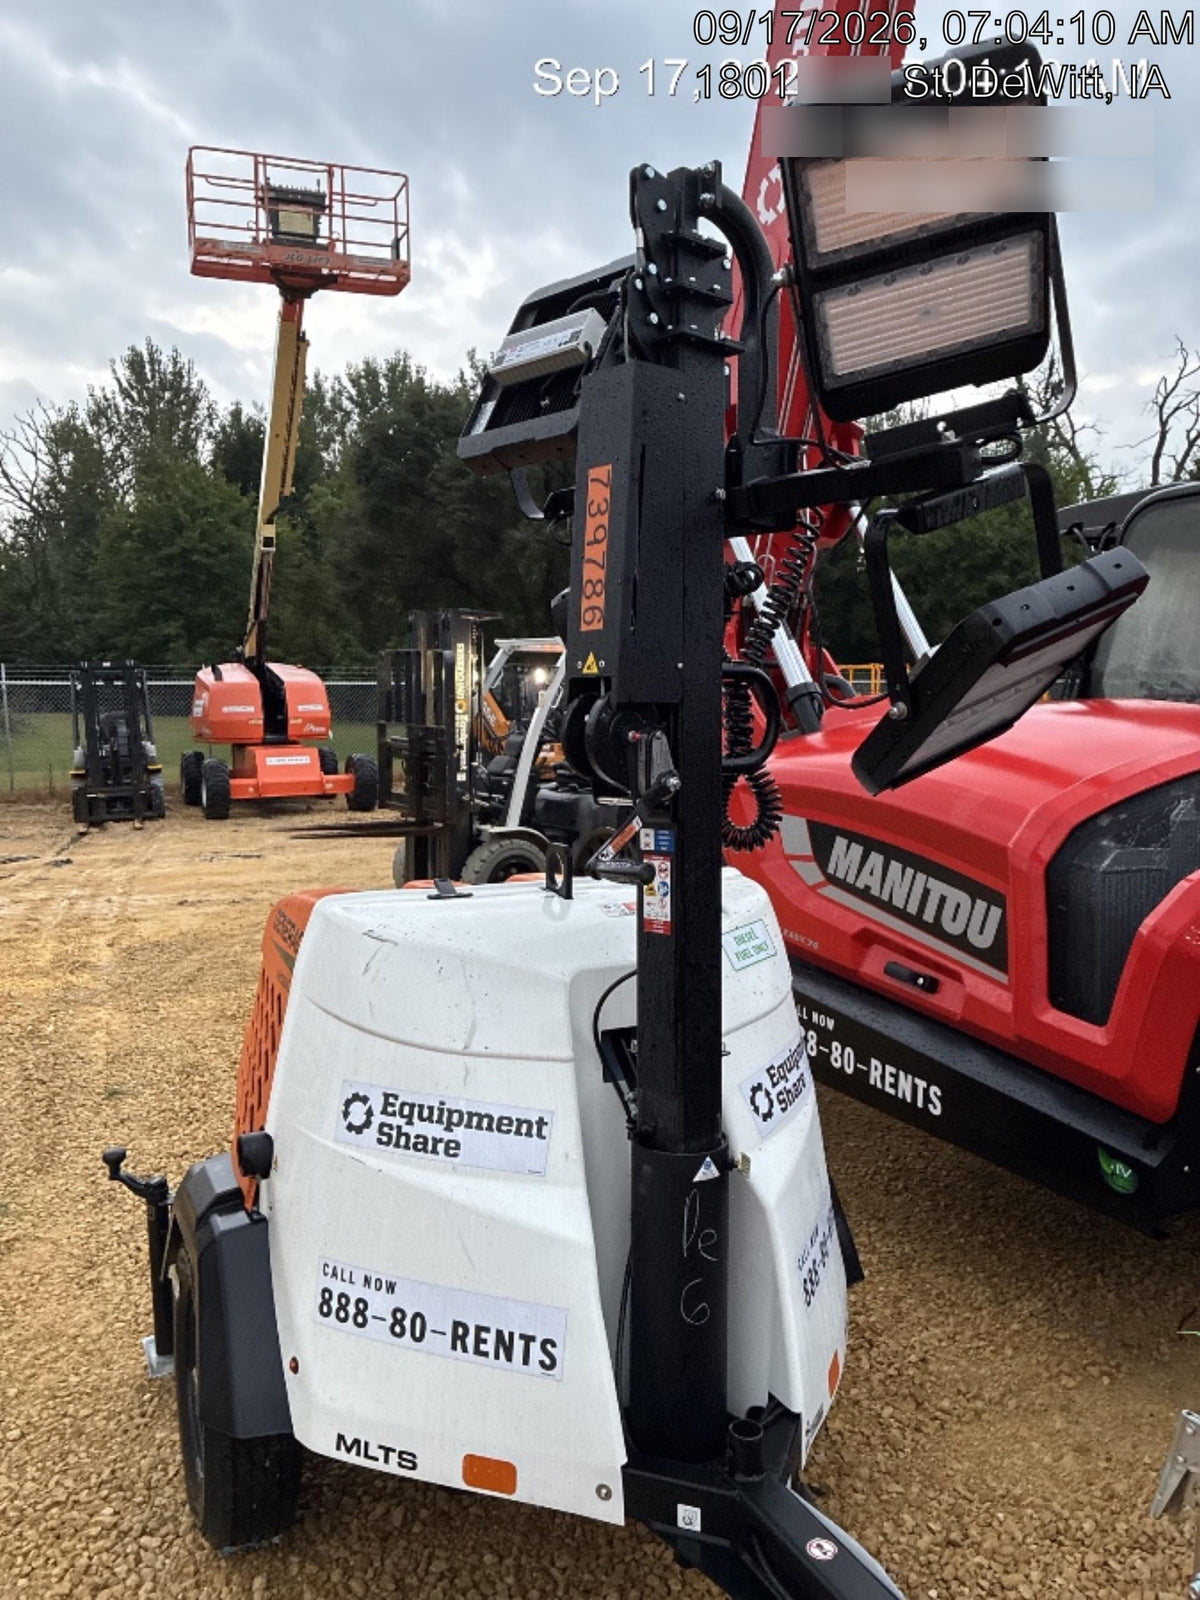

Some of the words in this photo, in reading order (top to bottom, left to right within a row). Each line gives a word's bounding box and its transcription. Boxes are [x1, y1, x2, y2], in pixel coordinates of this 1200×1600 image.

[581, 467, 611, 626] 739786
[827, 835, 1002, 949] MANITOU
[812, 1010, 835, 1031] NOW
[380, 1092, 549, 1140] Equipment
[376, 1121, 462, 1159] Share
[322, 1263, 356, 1286] CALL
[363, 1273, 398, 1295] NOW
[318, 1286, 558, 1372] 888-80-RENTS
[335, 1432, 418, 1472] MLTS
